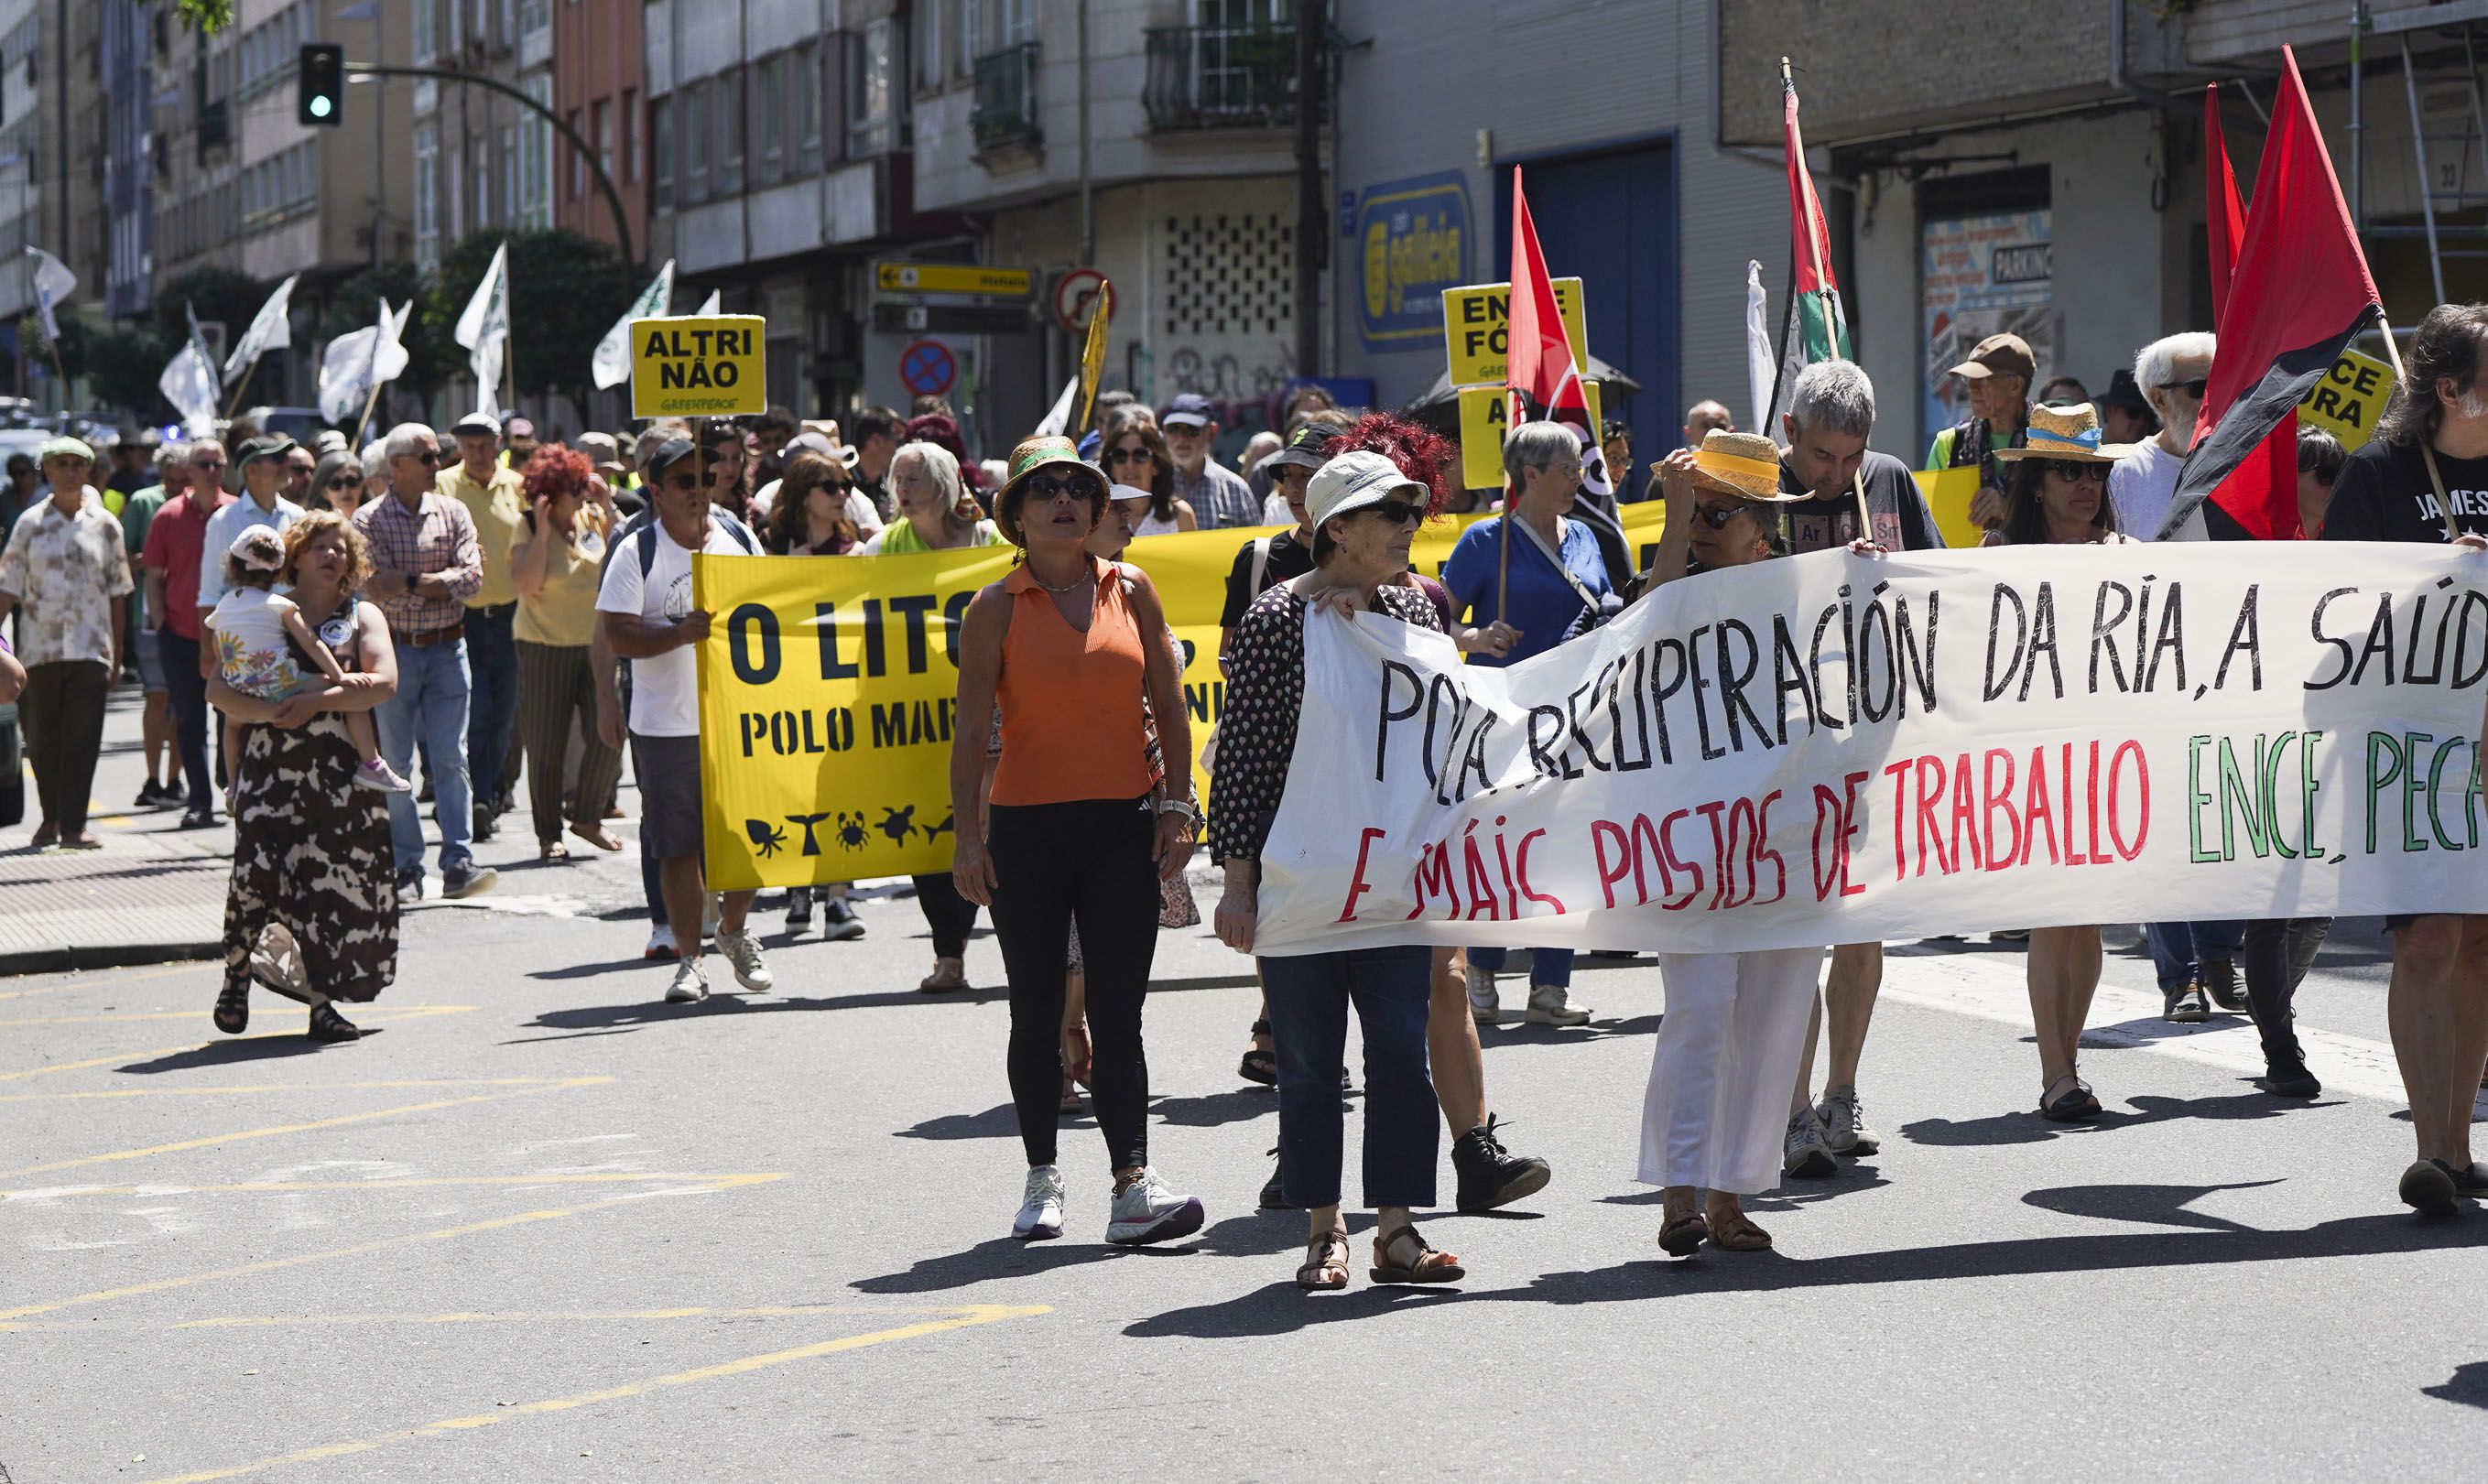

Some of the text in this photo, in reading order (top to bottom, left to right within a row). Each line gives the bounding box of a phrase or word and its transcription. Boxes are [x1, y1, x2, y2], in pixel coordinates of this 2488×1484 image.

[645, 330, 752, 358] ALTRI
[1465, 322, 1508, 357] FÓ
[660, 357, 738, 389] NÃO
[2330, 358, 2381, 397] CE
[660, 398, 739, 411] GREENPEACE
[728, 602, 781, 685] O
[1516, 580, 1939, 788] RECUPERACIÓN
[1983, 581, 2064, 703] DA
[740, 707, 853, 757] POLO
[1592, 789, 1786, 911] POSTOS
[1812, 770, 1868, 903] DE
[1884, 739, 2149, 882] TRABALLO
